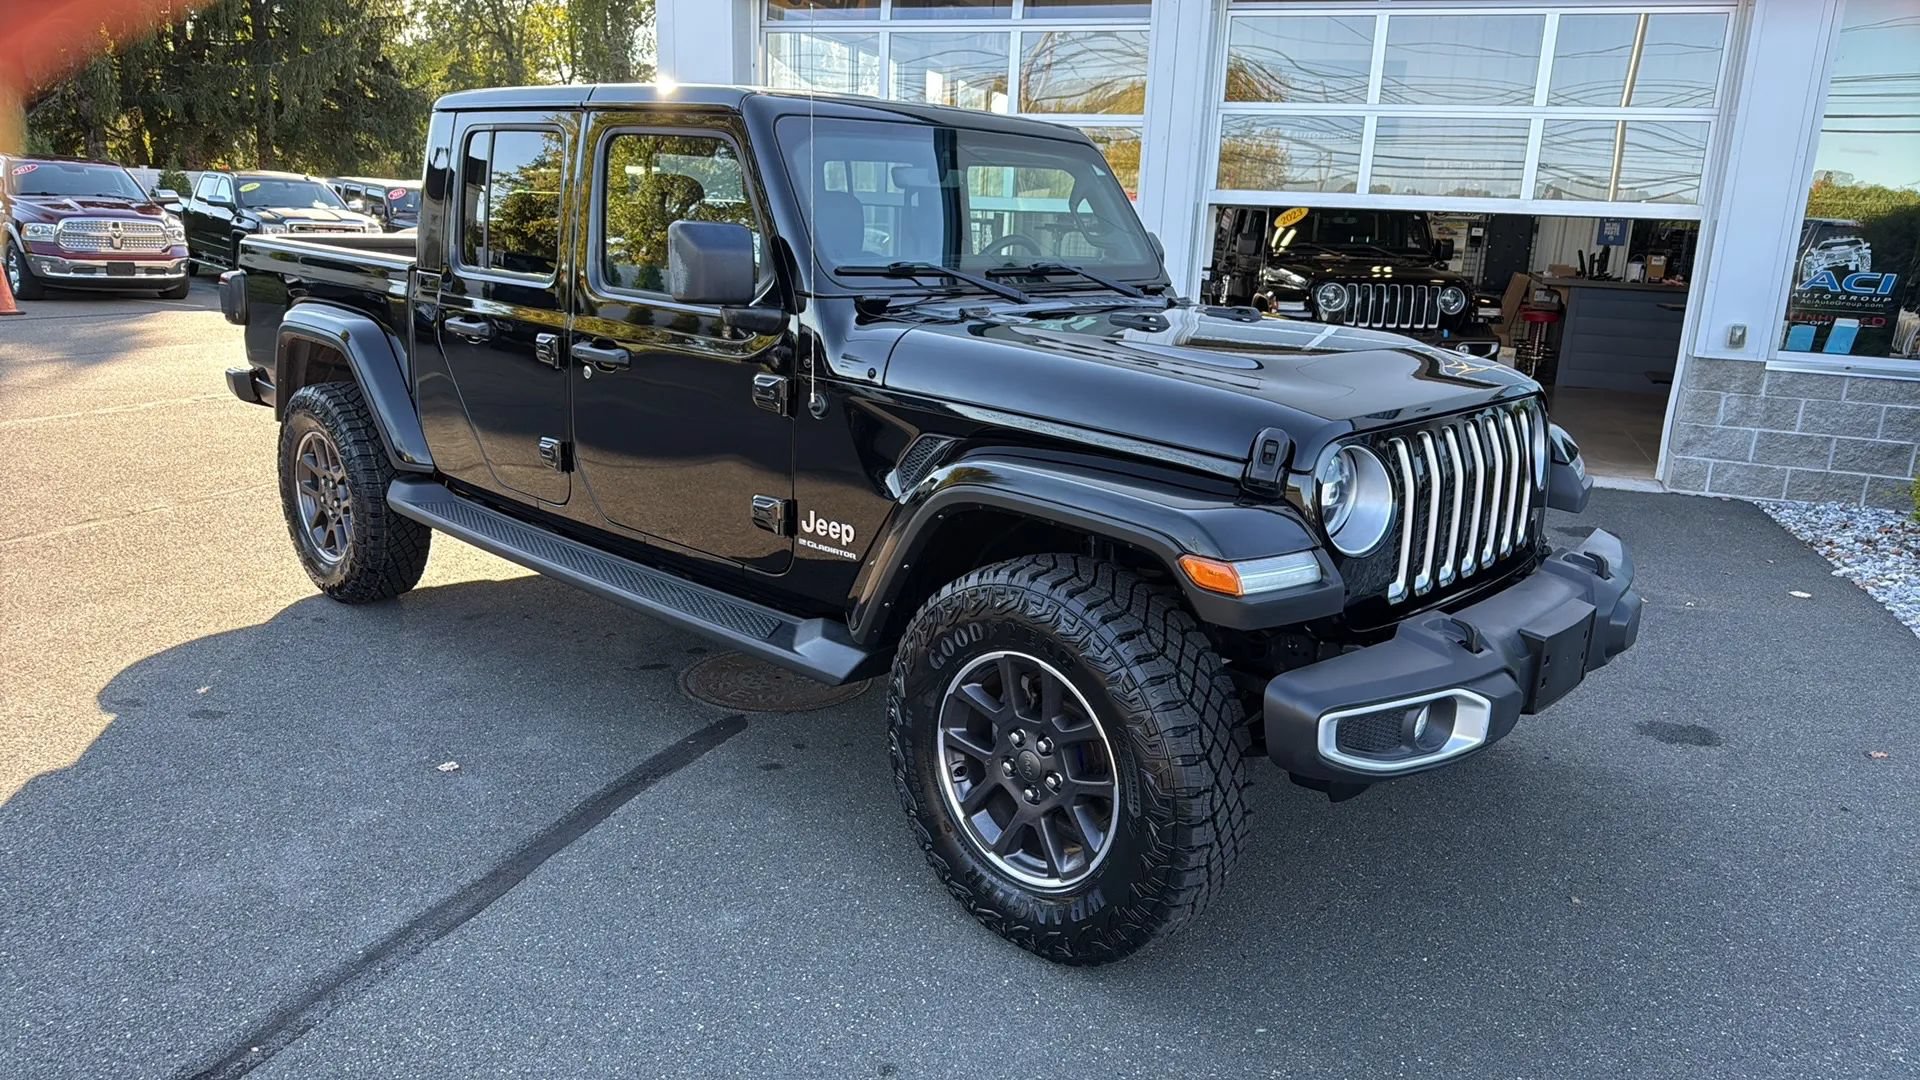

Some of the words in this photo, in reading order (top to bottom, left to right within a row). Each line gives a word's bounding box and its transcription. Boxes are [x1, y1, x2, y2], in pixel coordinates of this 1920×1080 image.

[1280, 208, 1303, 225] 2023
[1796, 270, 1897, 294] ACI
[1791, 292, 1832, 300] AUTO
[1838, 294, 1893, 303] GROUP
[801, 509, 855, 547] Jeep
[806, 540, 857, 560] GLADIATOR
